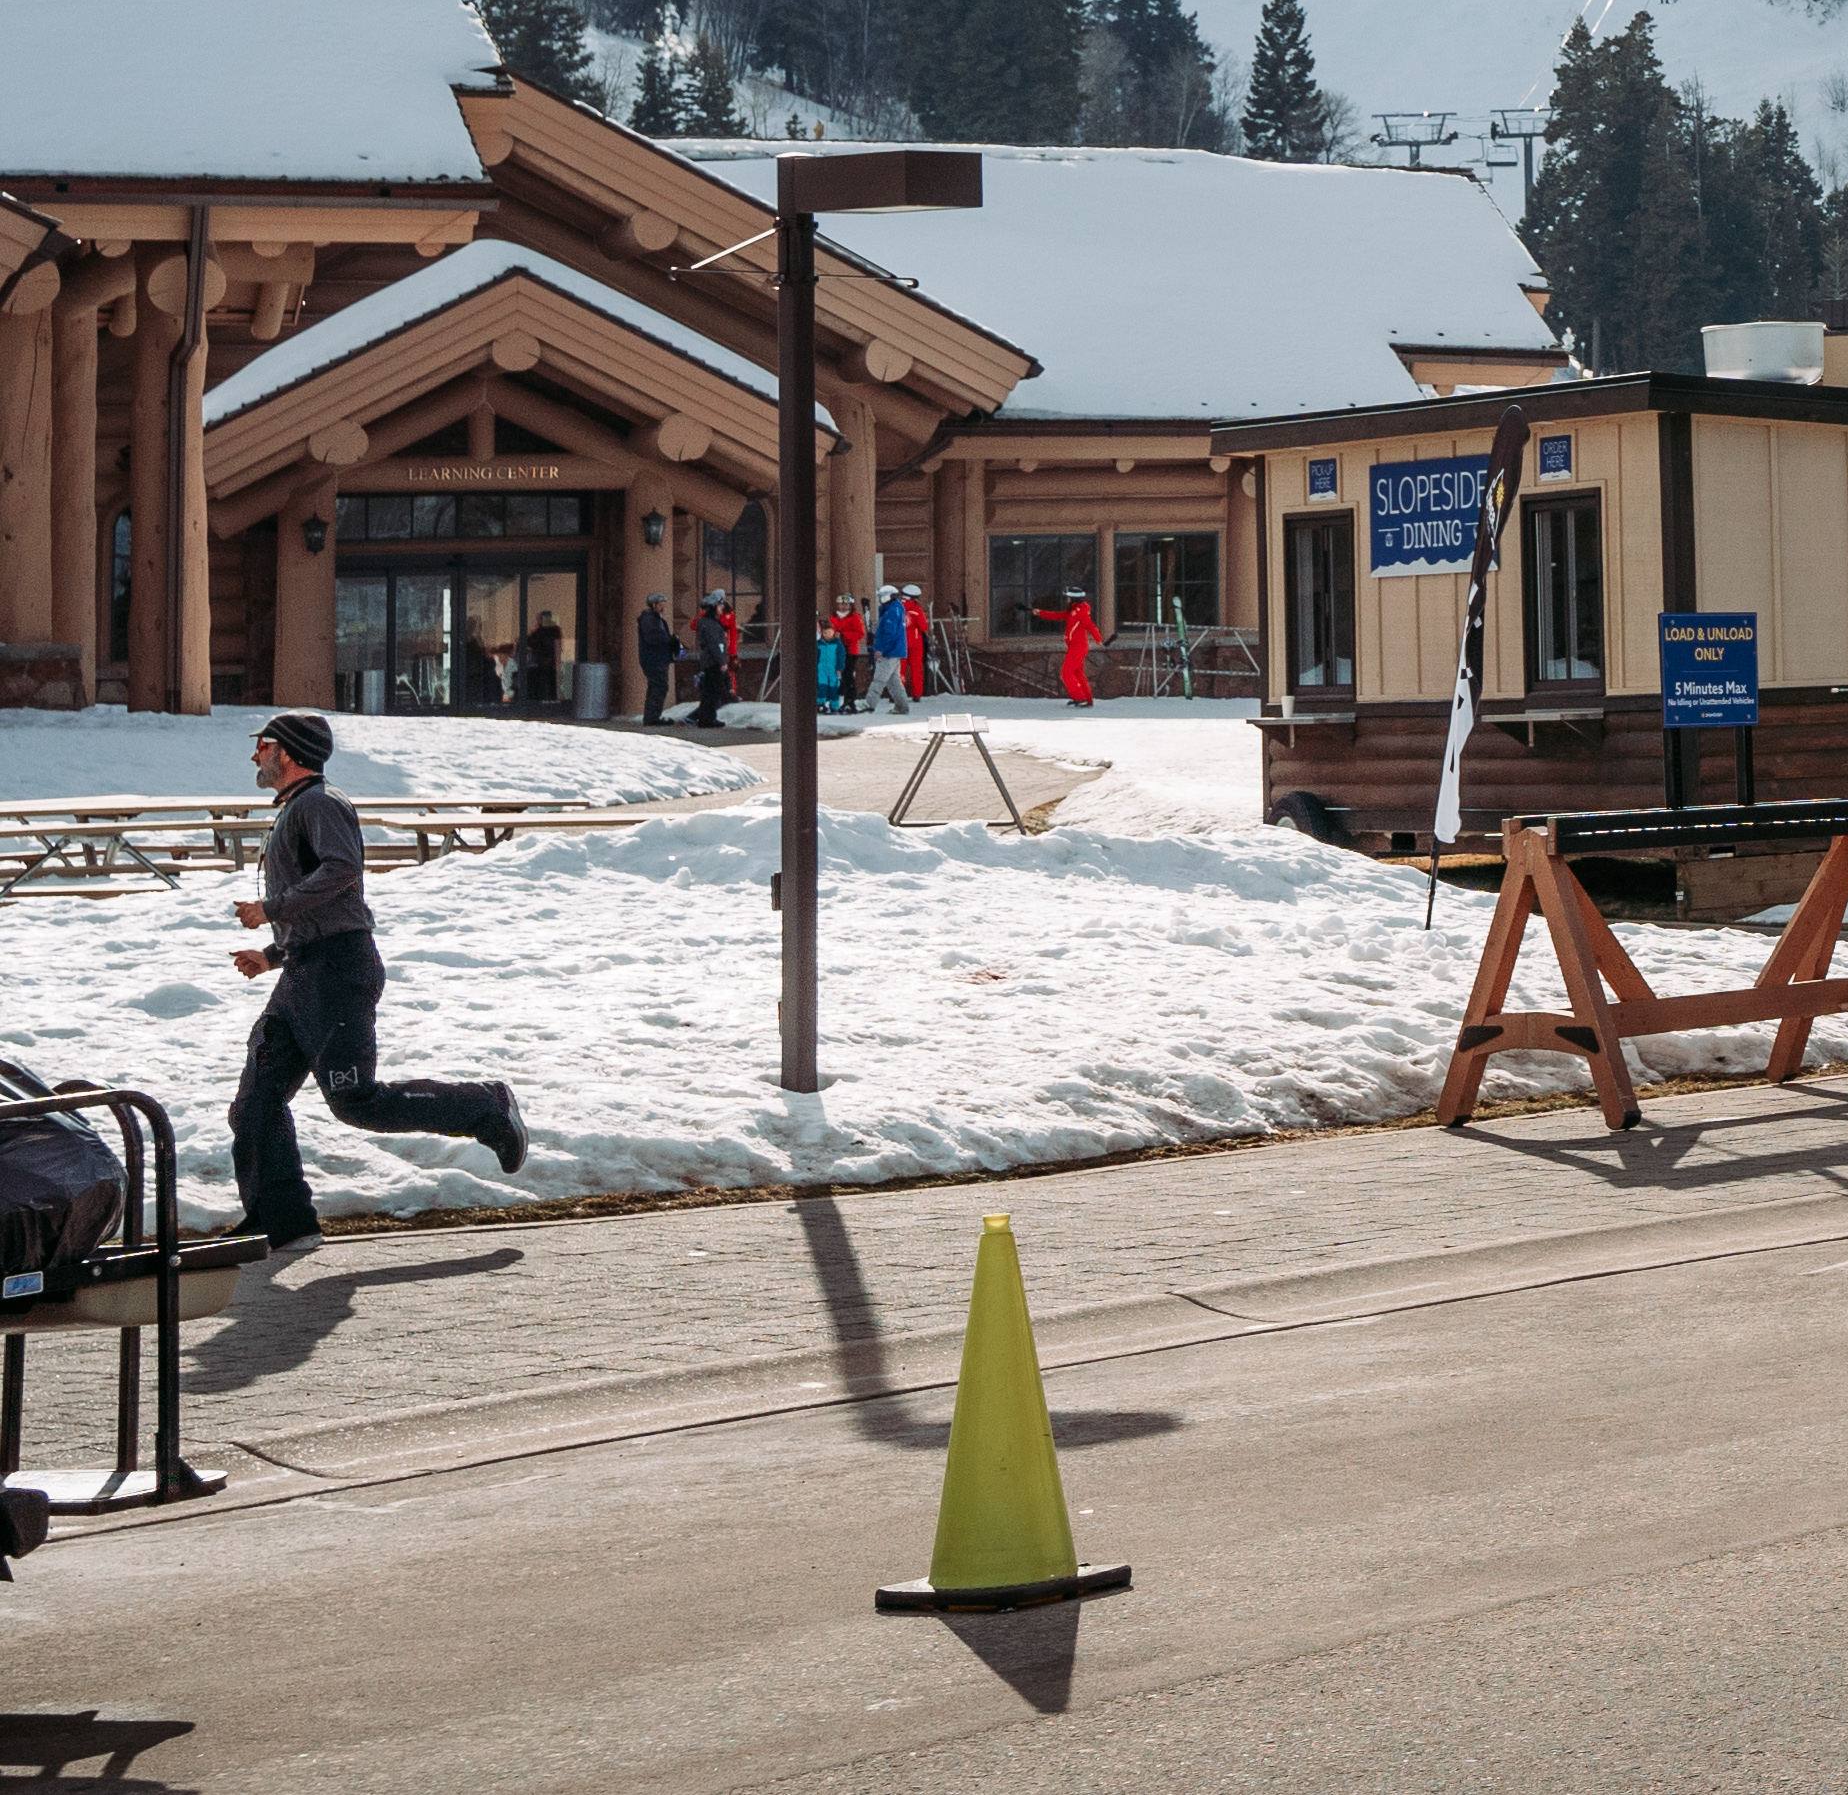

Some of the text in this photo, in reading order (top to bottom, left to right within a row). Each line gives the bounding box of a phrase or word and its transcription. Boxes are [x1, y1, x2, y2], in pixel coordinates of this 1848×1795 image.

[1543, 440, 1568, 455] ORDER
[1546, 455, 1565, 469] HERE
[408, 465, 560, 481] LEARNING CENTER
[1314, 477, 1332, 490] HERE
[1376, 469, 1488, 516] SLOPESIDE
[1402, 519, 1463, 550] DINING
[1665, 627, 1754, 641] LOAD & UNLOAD
[1694, 647, 1725, 661] ONLY
[1675, 681, 1748, 695] 5 Minutes Max
[1668, 698, 1677, 706] No
[1677, 698, 1692, 708] Idling
